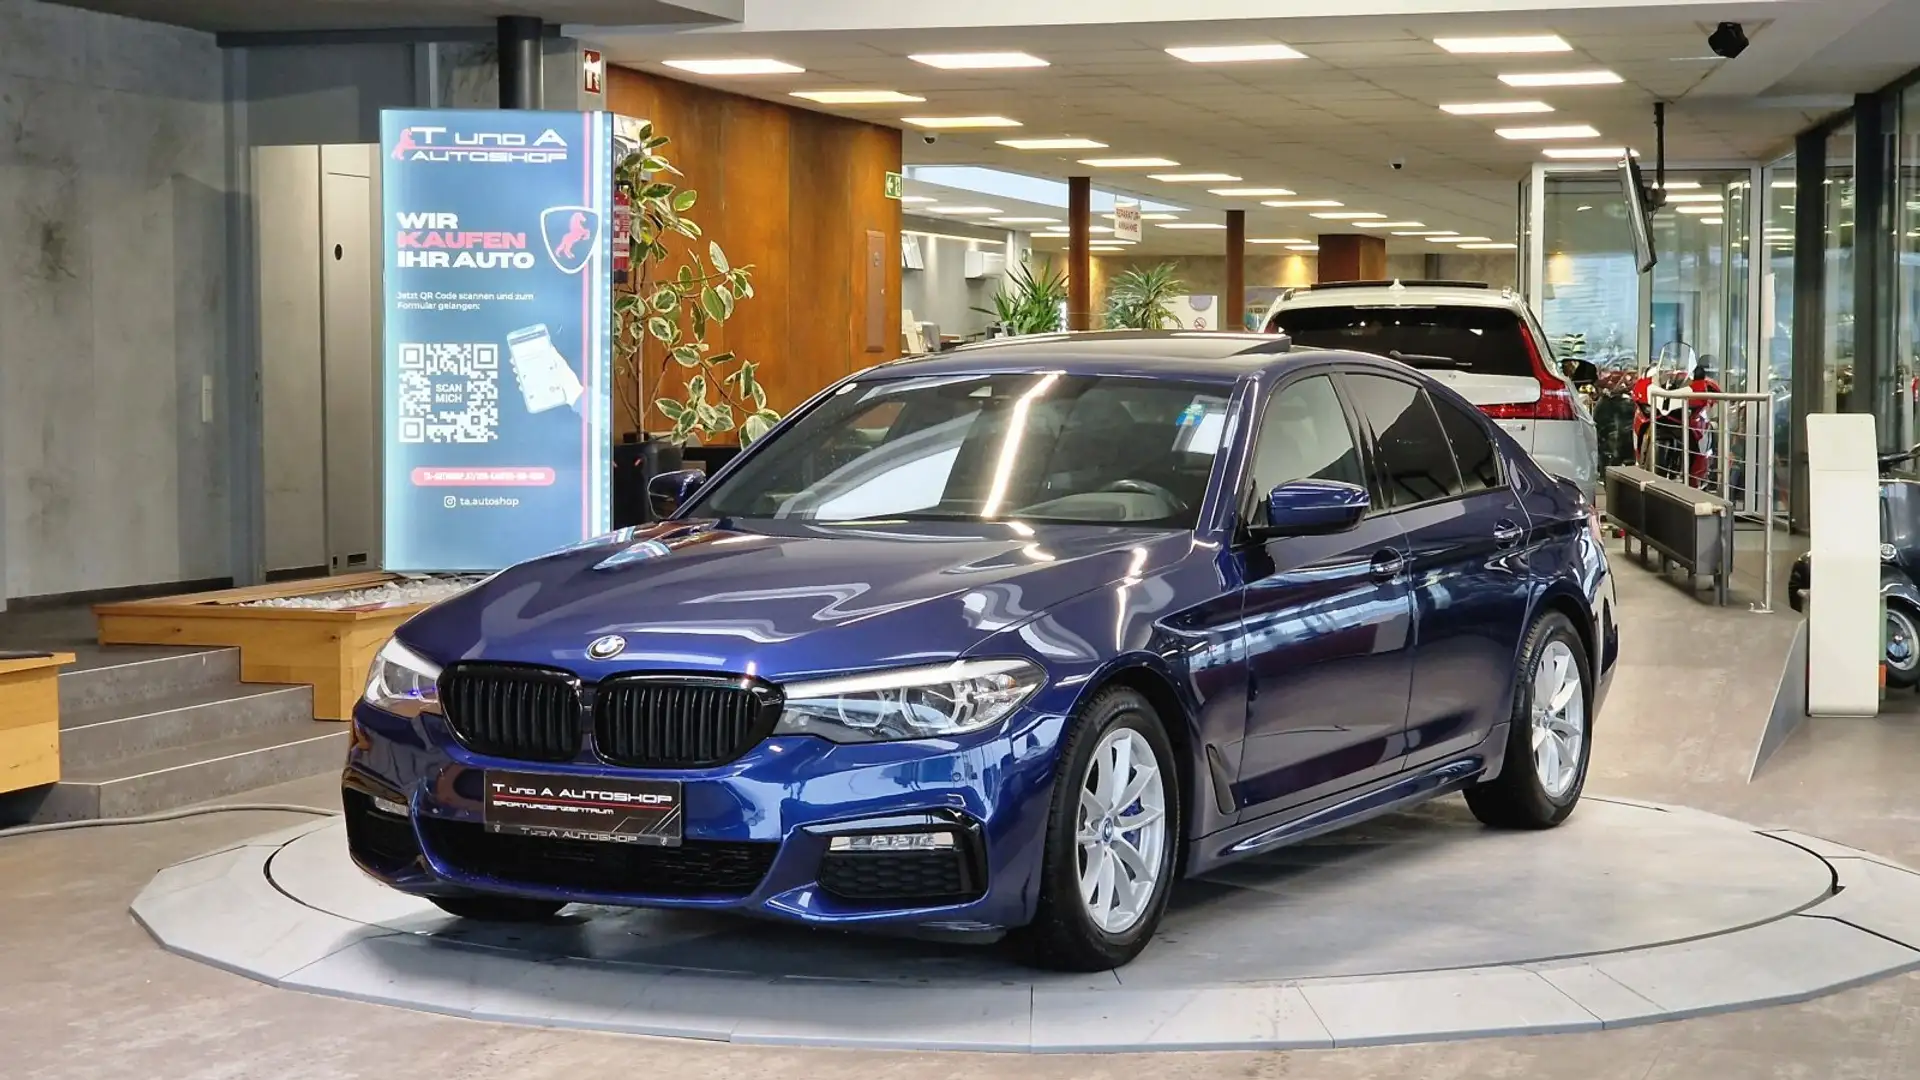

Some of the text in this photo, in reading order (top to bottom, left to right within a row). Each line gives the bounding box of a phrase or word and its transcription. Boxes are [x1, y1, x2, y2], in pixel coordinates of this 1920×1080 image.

[411, 126, 447, 144] T
[533, 128, 568, 147] A
[411, 150, 568, 164] AUTOSHOP
[396, 212, 458, 229] WIR
[397, 231, 526, 249] KAUFEN
[397, 250, 536, 269] IHR AUTO
[396, 291, 534, 301] Jetzt QR Code scannen und zum
[397, 301, 437, 310] Formular
[435, 383, 462, 392] SCAN
[435, 393, 462, 403] MICH
[459, 497, 520, 507] ta.autoshop
[492, 783, 505, 793] T
[541, 787, 554, 797] A
[559, 788, 673, 804] AUTOSHOP
[562, 831, 638, 844] AUTOSHOP
